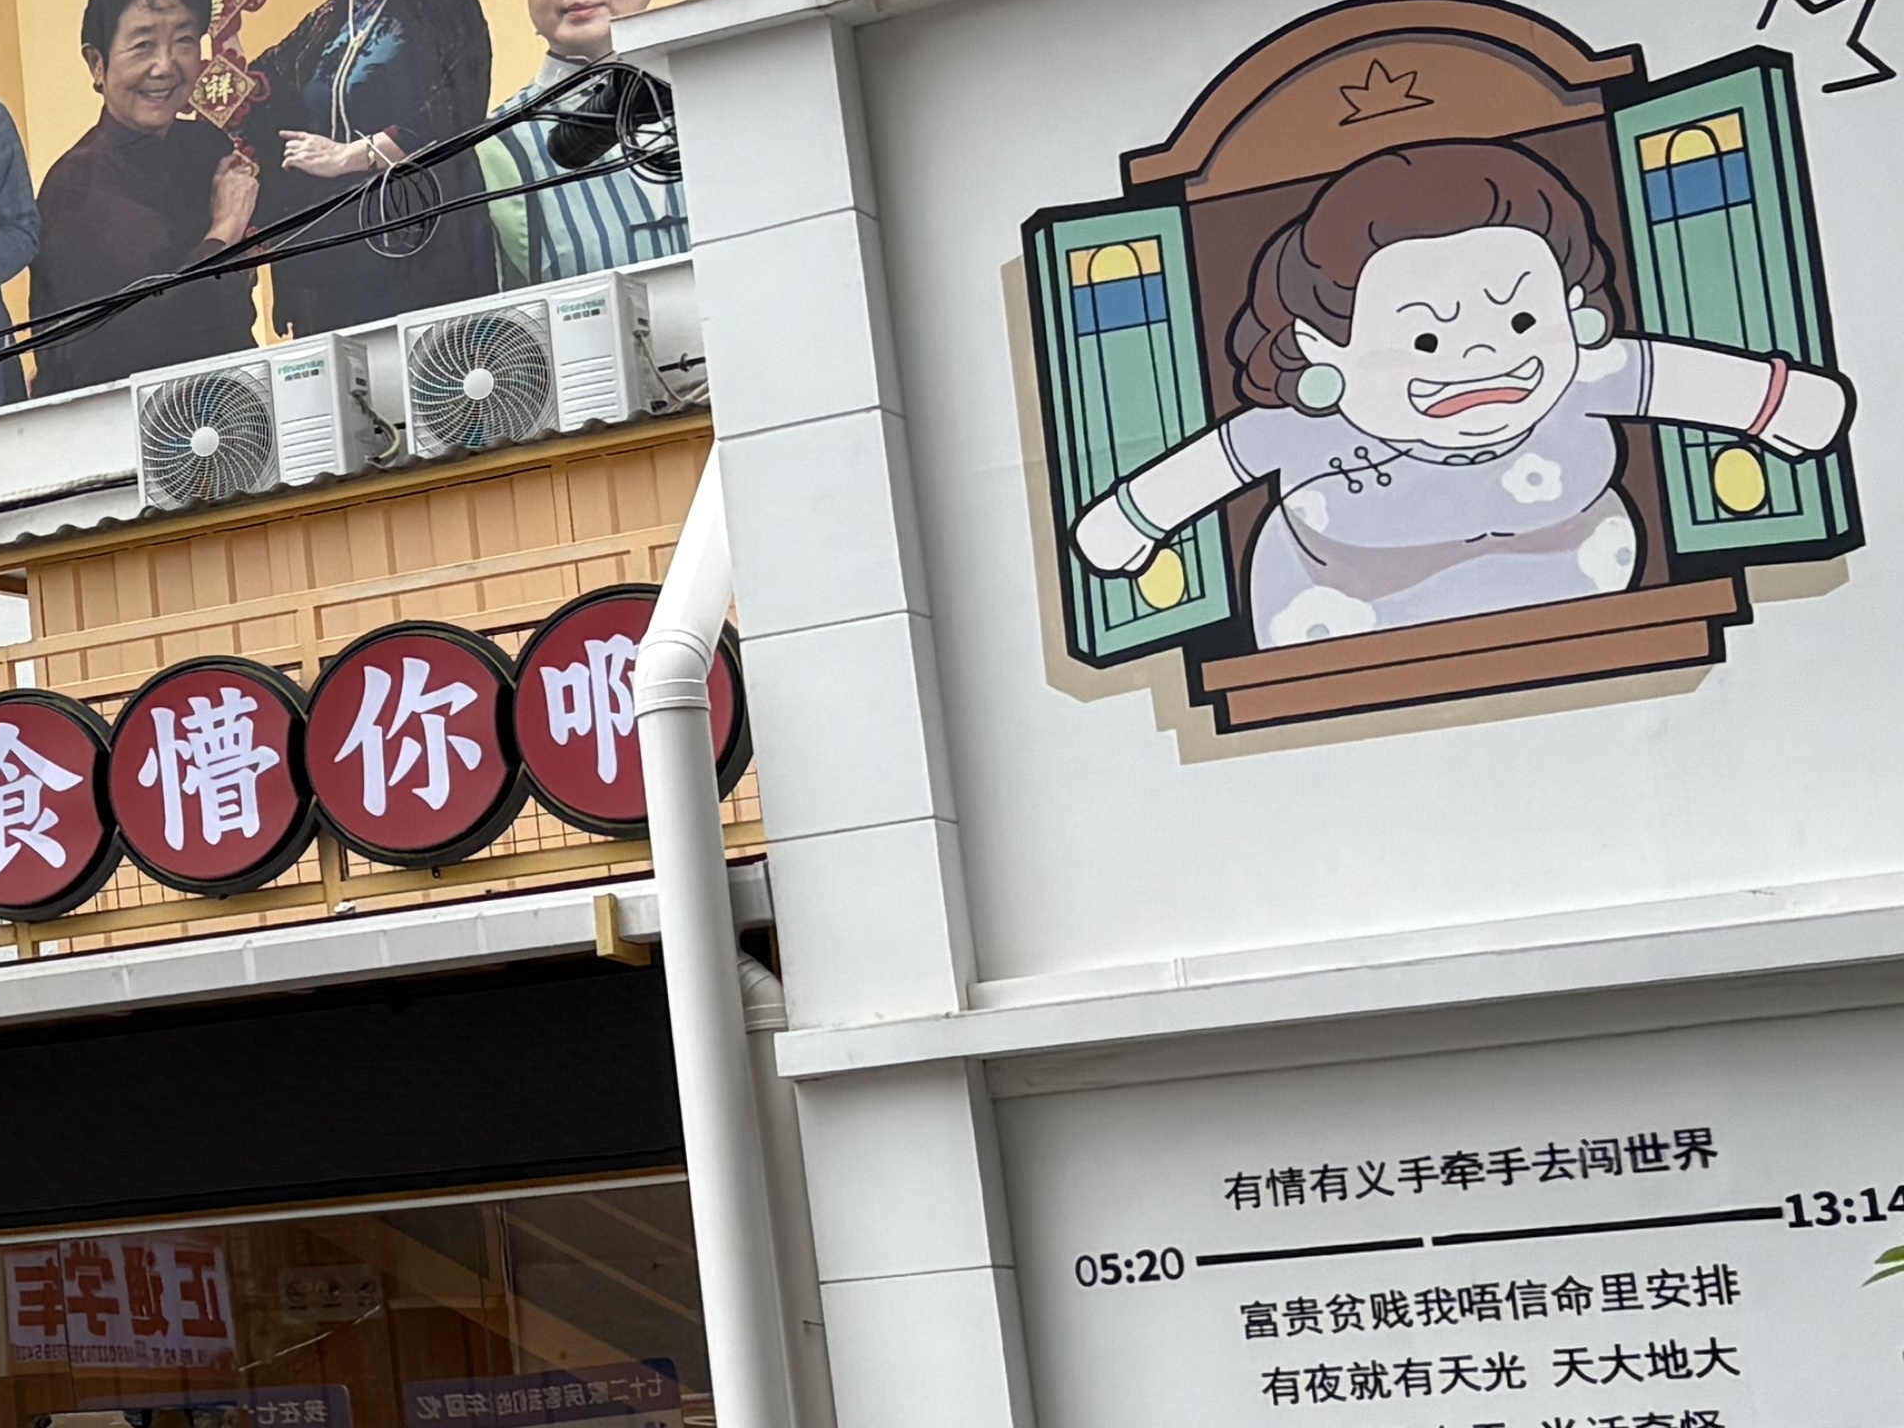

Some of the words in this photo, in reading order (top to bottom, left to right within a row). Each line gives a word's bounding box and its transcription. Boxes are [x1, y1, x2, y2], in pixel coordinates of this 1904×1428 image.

[1225, 1128, 1719, 1211] 有情有义手牵手去闯世界
[1076, 1247, 1185, 1288] 05:20
[1785, 1186, 1904, 1228] 13:14
[1241, 1264, 1741, 1339] 富贵贫贱我唔信命里安排
[1263, 1350, 1526, 1405] 有夜就有天光
[1552, 1337, 1740, 1387] 天大地大
